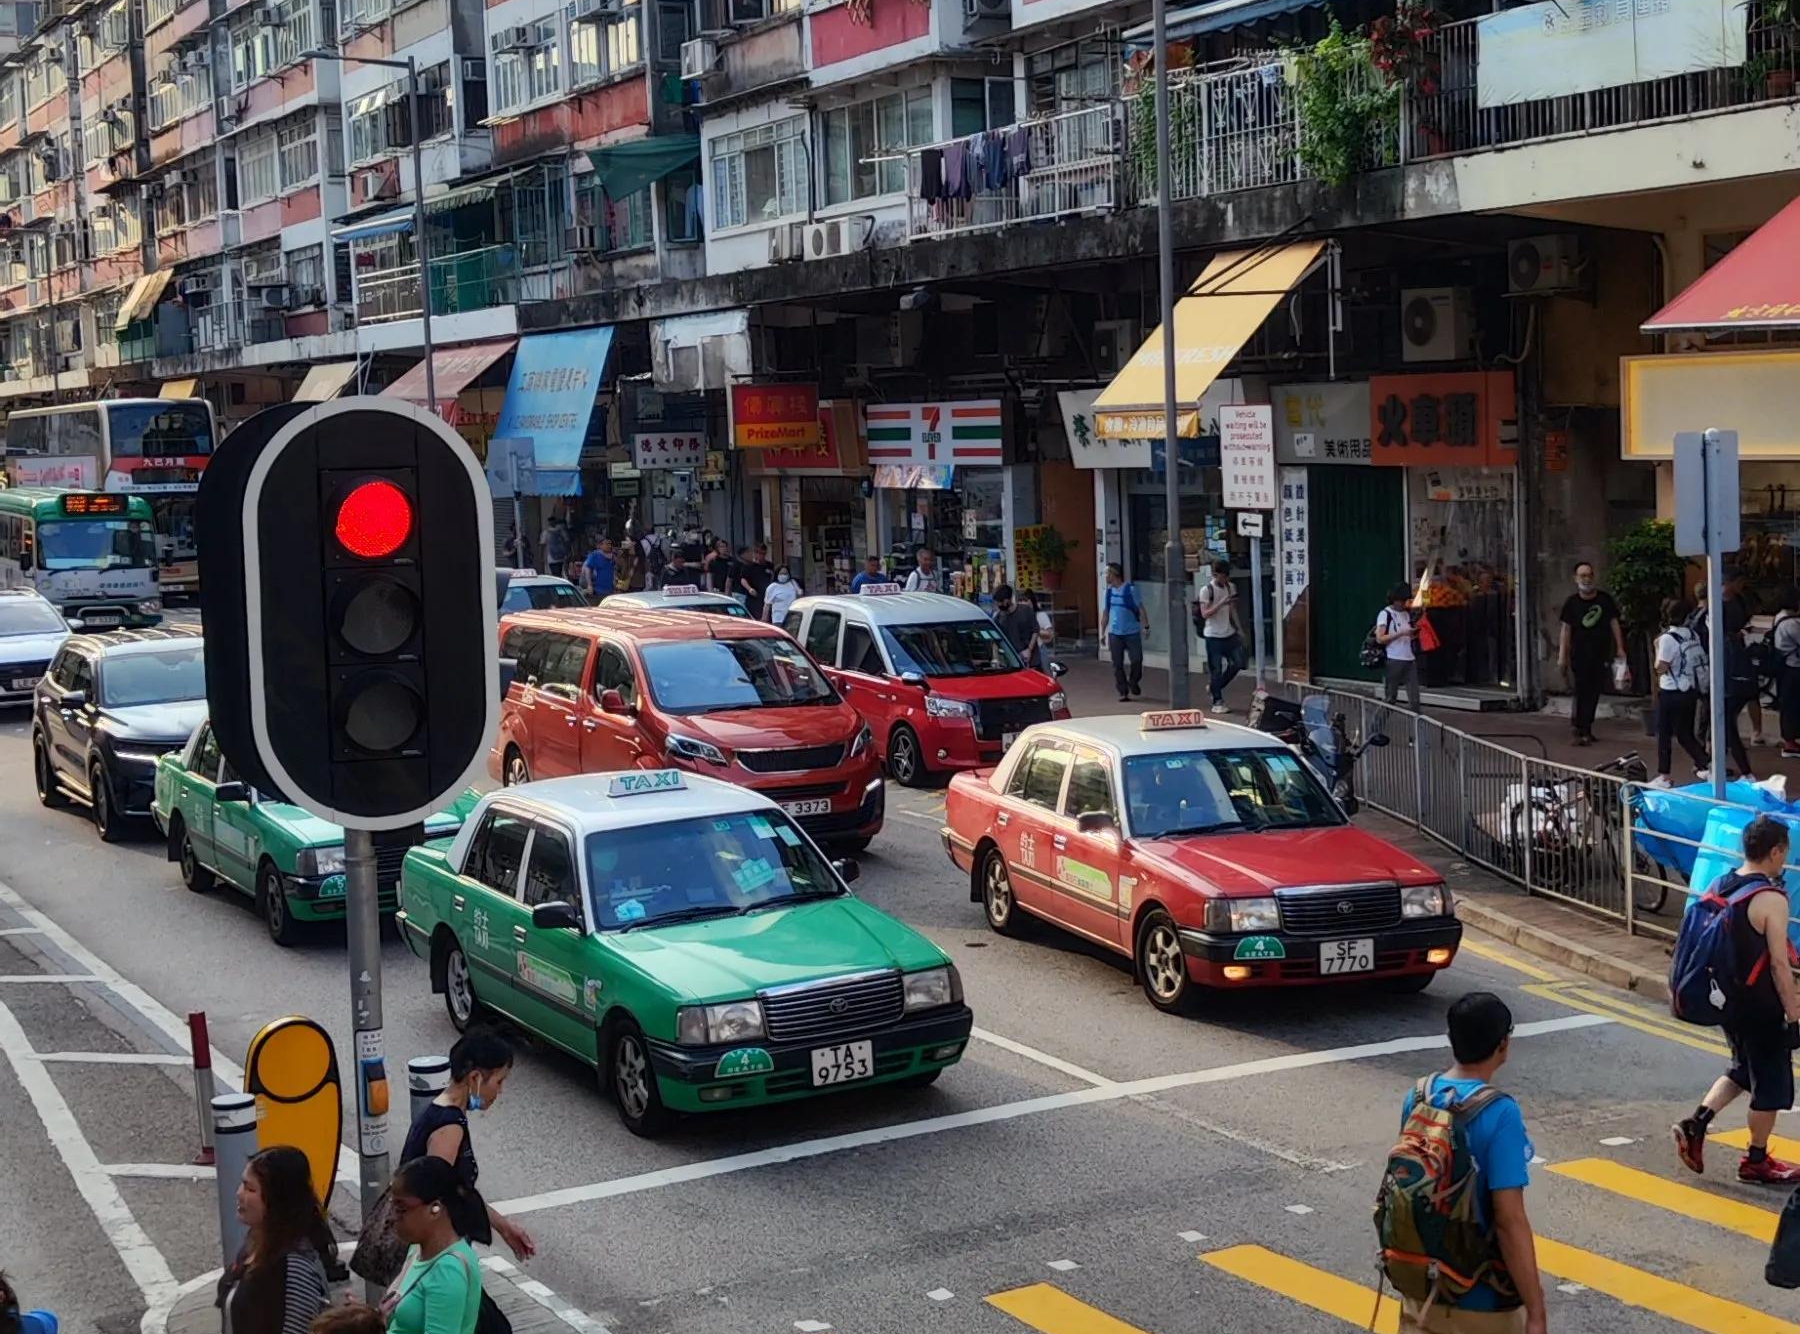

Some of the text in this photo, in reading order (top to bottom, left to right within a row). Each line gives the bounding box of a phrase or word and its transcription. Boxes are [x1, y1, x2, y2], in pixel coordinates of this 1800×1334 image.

[1225, 421, 1247, 431] waiting
[1377, 392, 1479, 448] 火車頭
[747, 426, 805, 440] PrizeMart
[1230, 432, 1263, 441] prosecuted
[1324, 438, 1371, 459] 美術用品
[867, 584, 898, 594] TAXI
[1149, 712, 1201, 727] TAXI
[619, 771, 680, 791] TAXI
[794, 799, 829, 815] 3373
[1020, 831, 1035, 848] 的士
[1020, 847, 1035, 868] TAXI
[473, 907, 489, 930] 的士
[473, 925, 489, 950] TAXI
[1254, 940, 1265, 951] 4
[1336, 941, 1358, 957] SF
[1325, 954, 1369, 973] 7770
[740, 1053, 750, 1065] 4
[830, 1045, 855, 1065] TA
[818, 1058, 869, 1084] 9753
